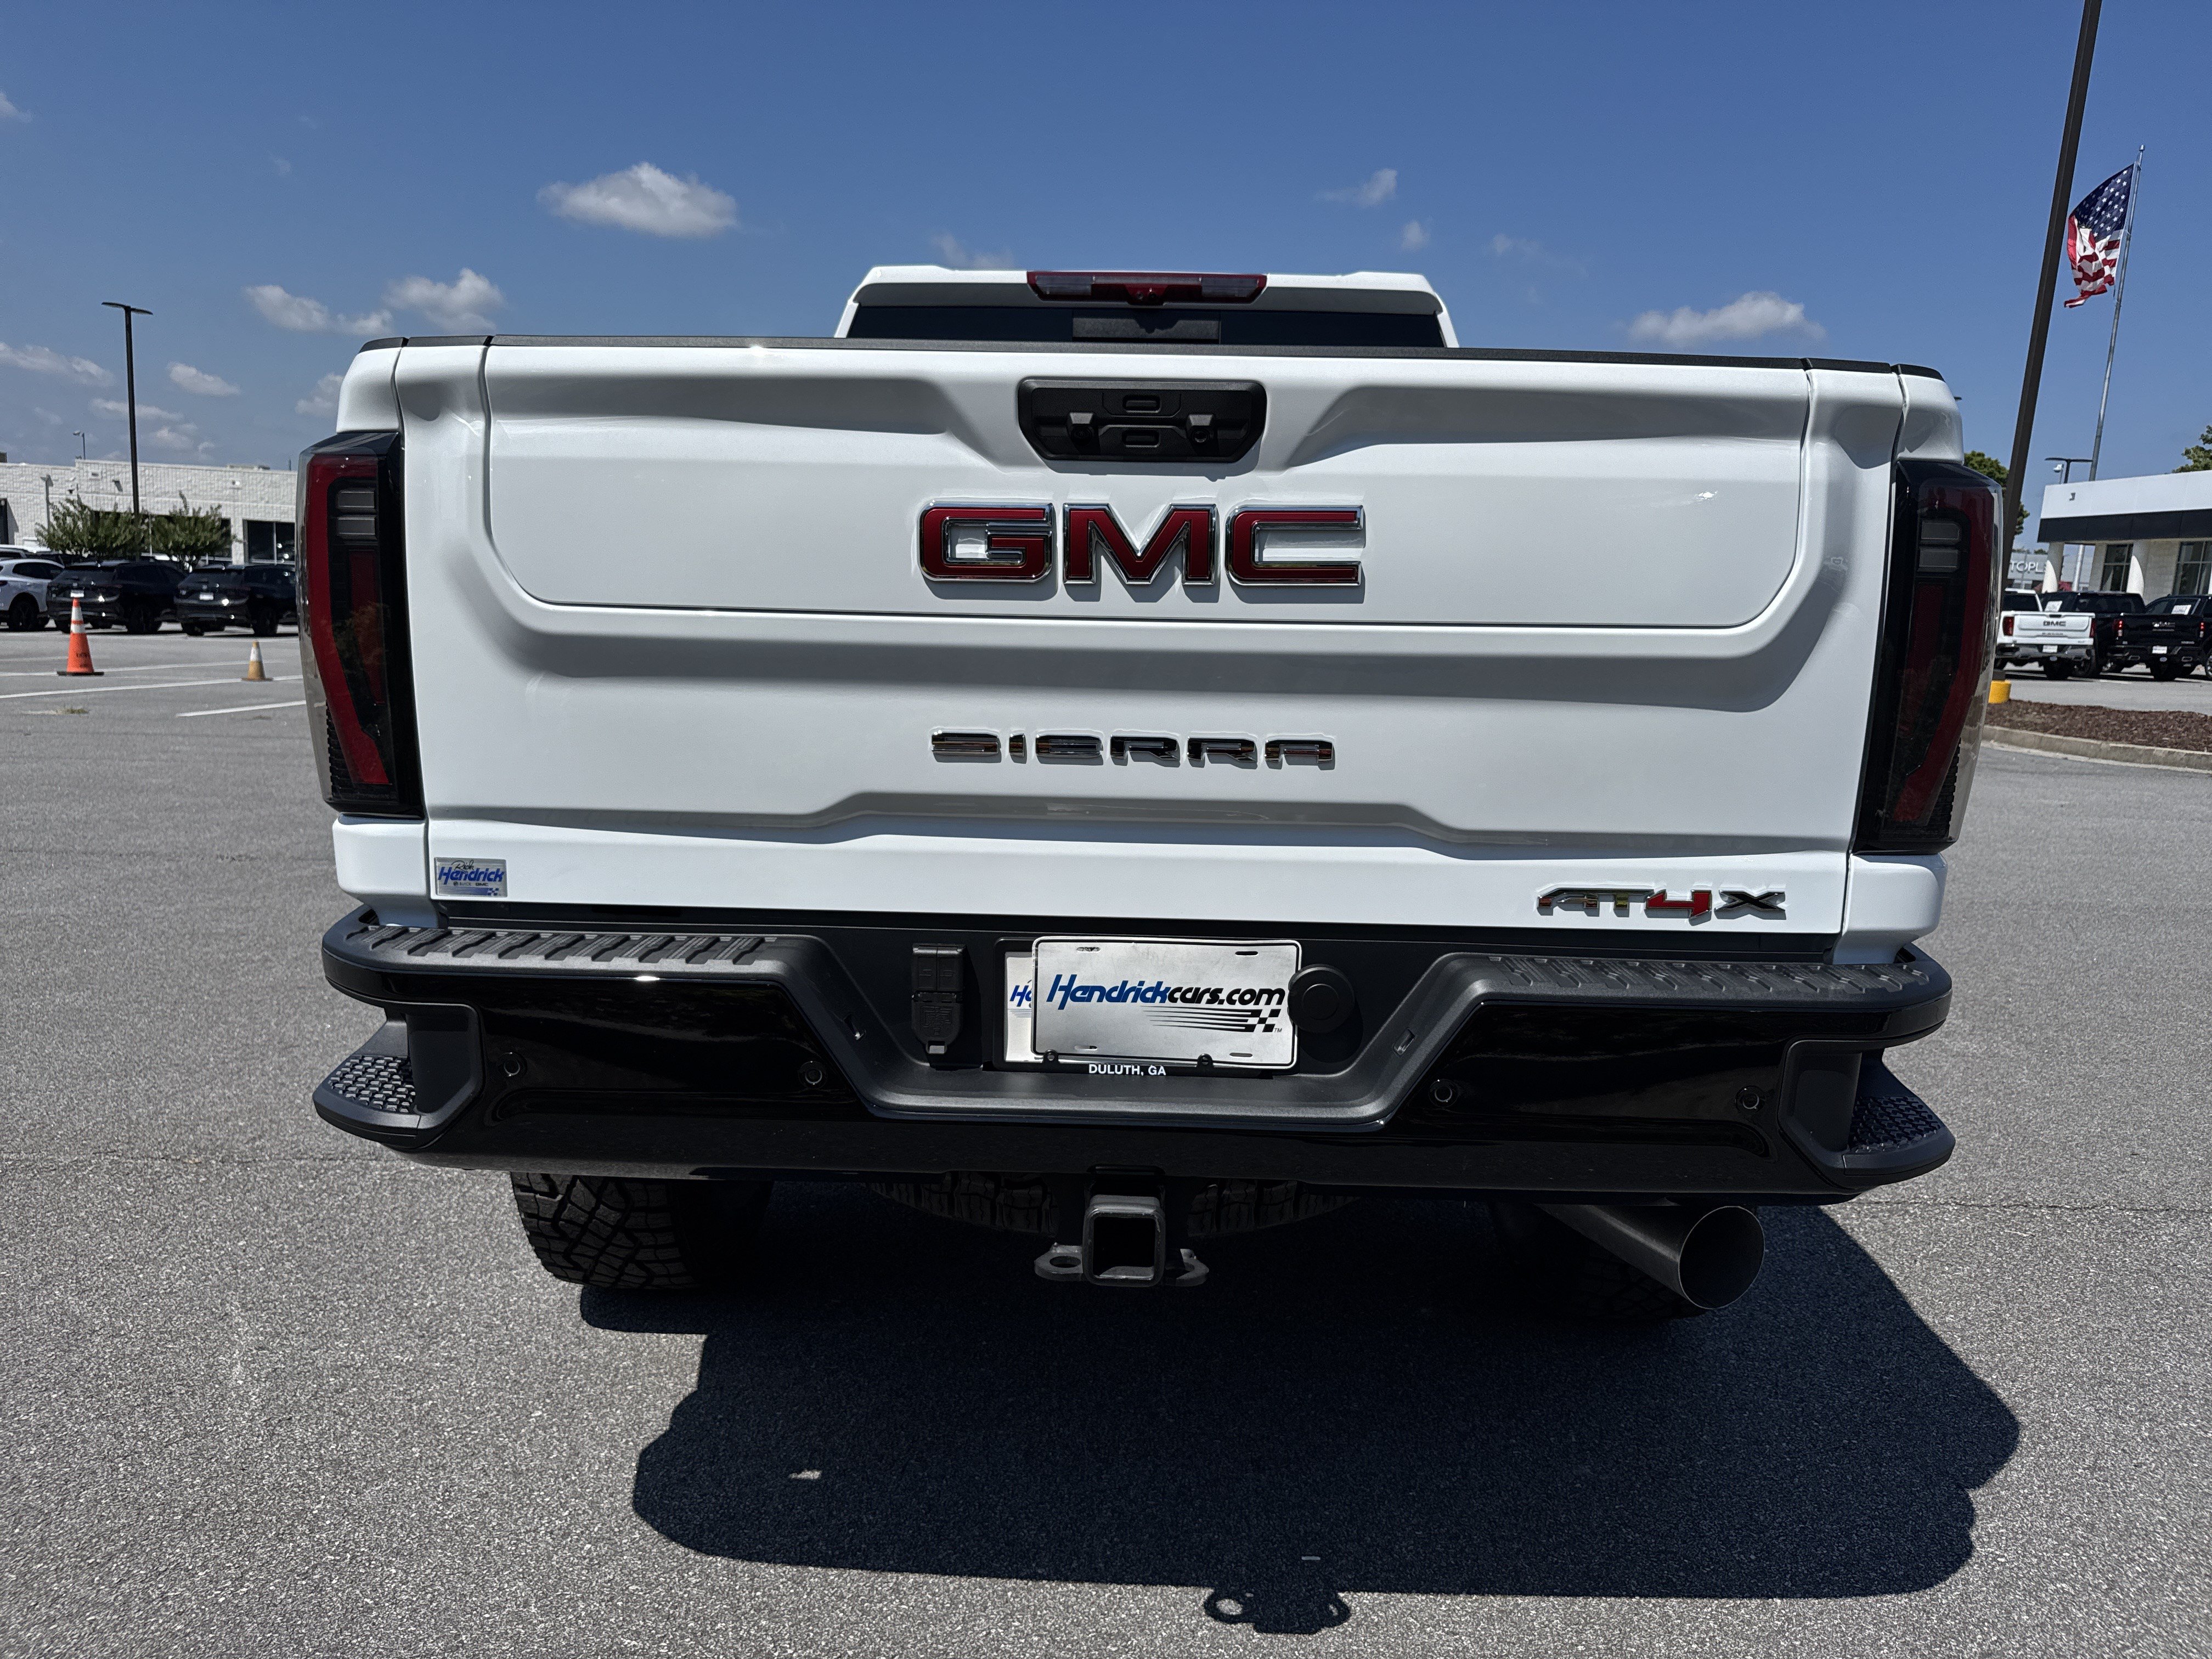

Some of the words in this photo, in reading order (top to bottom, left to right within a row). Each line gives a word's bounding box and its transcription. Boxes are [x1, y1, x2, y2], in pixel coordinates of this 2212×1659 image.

[918, 502, 1363, 585] GMC
[932, 732, 1333, 763] SIERRA
[438, 866, 505, 885] Hendrick
[1538, 887, 1786, 918] AT4X
[1046, 974, 1285, 1010] Hendrickcars.com
[1088, 1064, 1144, 1076] DULUTH,
[1148, 1065, 1166, 1076] GA
